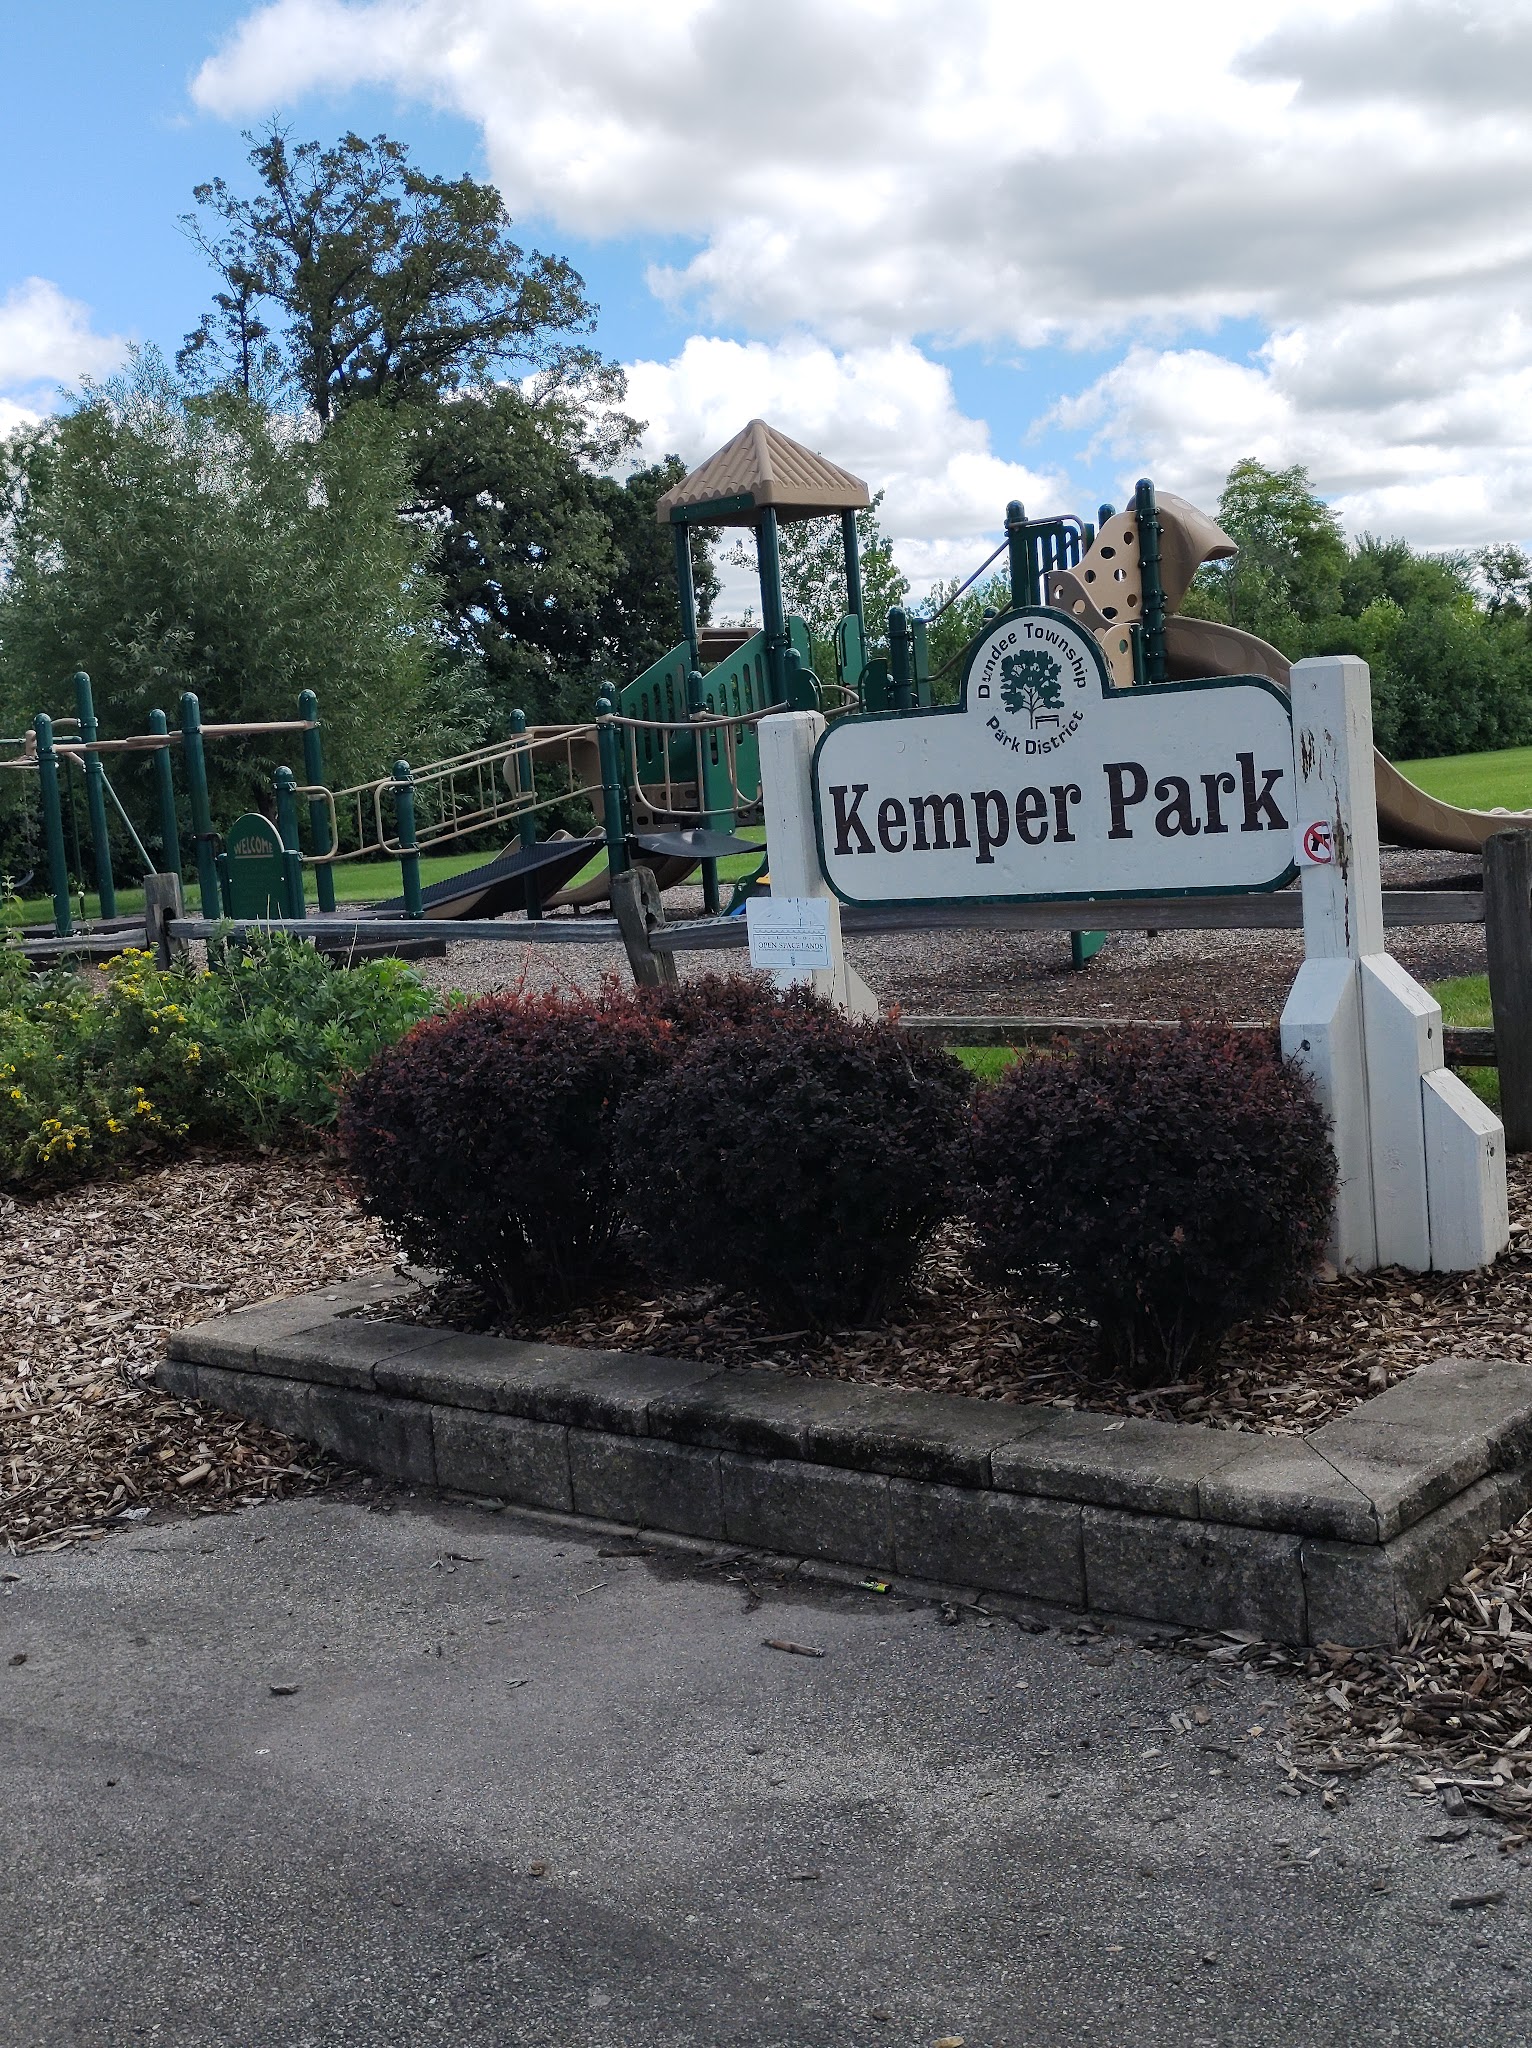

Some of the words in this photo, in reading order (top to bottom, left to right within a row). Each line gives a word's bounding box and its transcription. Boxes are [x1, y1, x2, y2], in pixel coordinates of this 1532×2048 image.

[978, 632, 1017, 698] Dundee
[1024, 622, 1088, 689] Township
[986, 715, 1020, 752] Park
[1025, 710, 1083, 755] District
[829, 783, 1082, 864] Kemper
[1103, 752, 1289, 839] Park
[234, 836, 273, 854] WELCOME
[801, 942, 823, 950] LANDS
